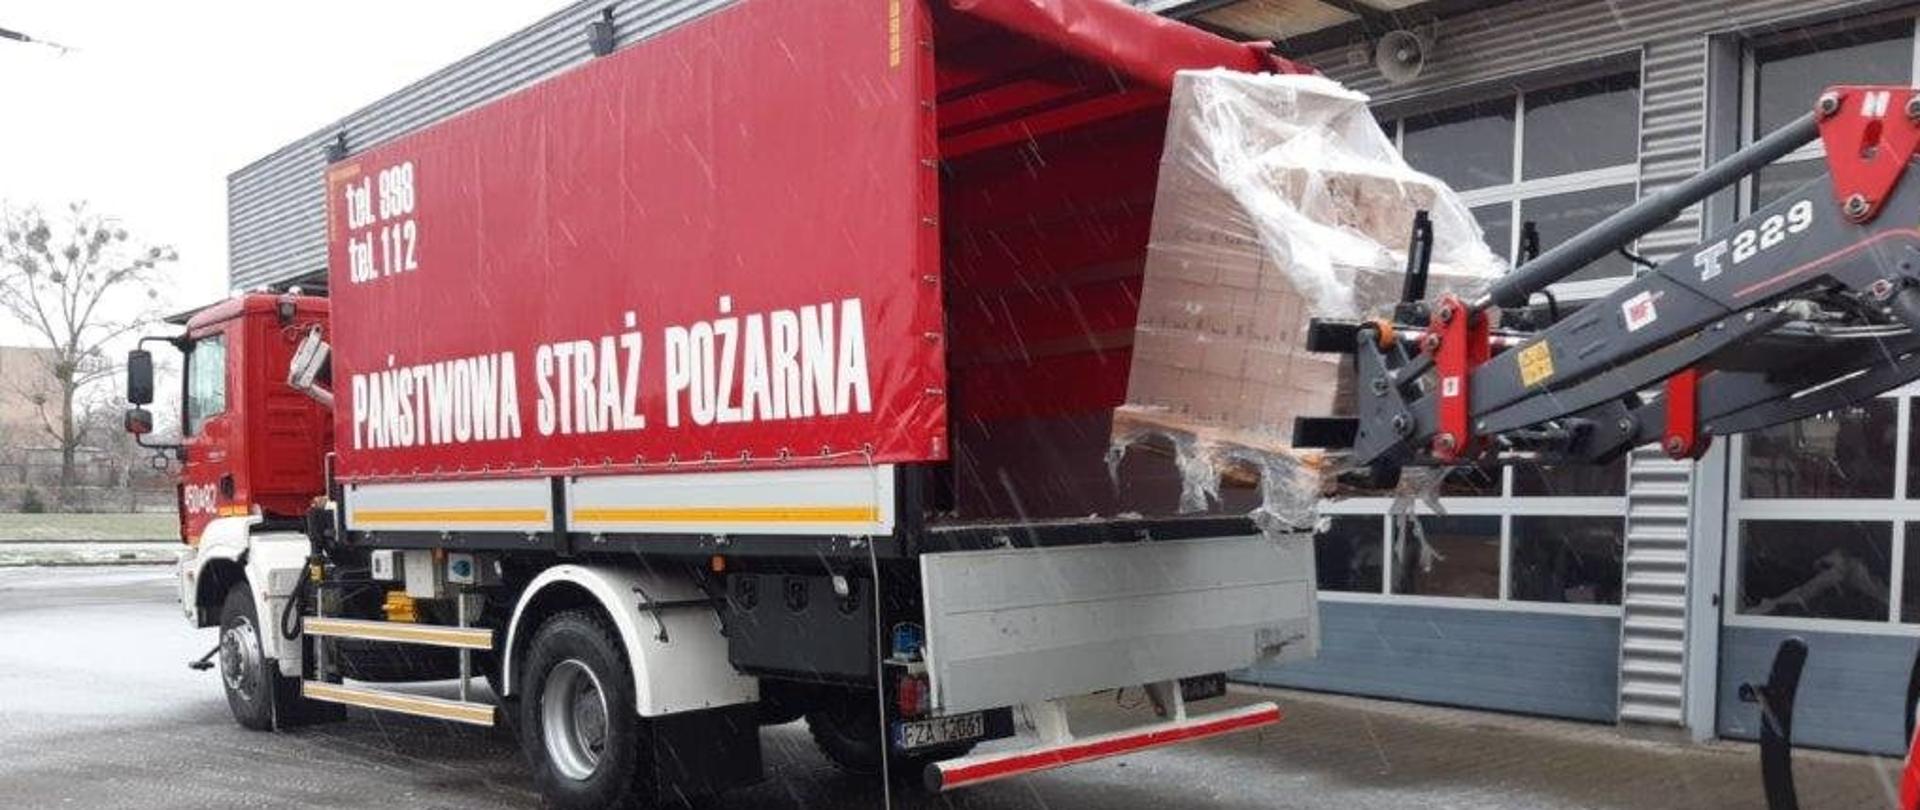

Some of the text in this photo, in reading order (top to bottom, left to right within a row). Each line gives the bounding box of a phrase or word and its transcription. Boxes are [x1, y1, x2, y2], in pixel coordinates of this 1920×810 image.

[379, 161, 415, 219] 998
[348, 219, 418, 283] tel. 112
[352, 295, 873, 450] PAŃSTWOWA STRAŻ POŻARNA
